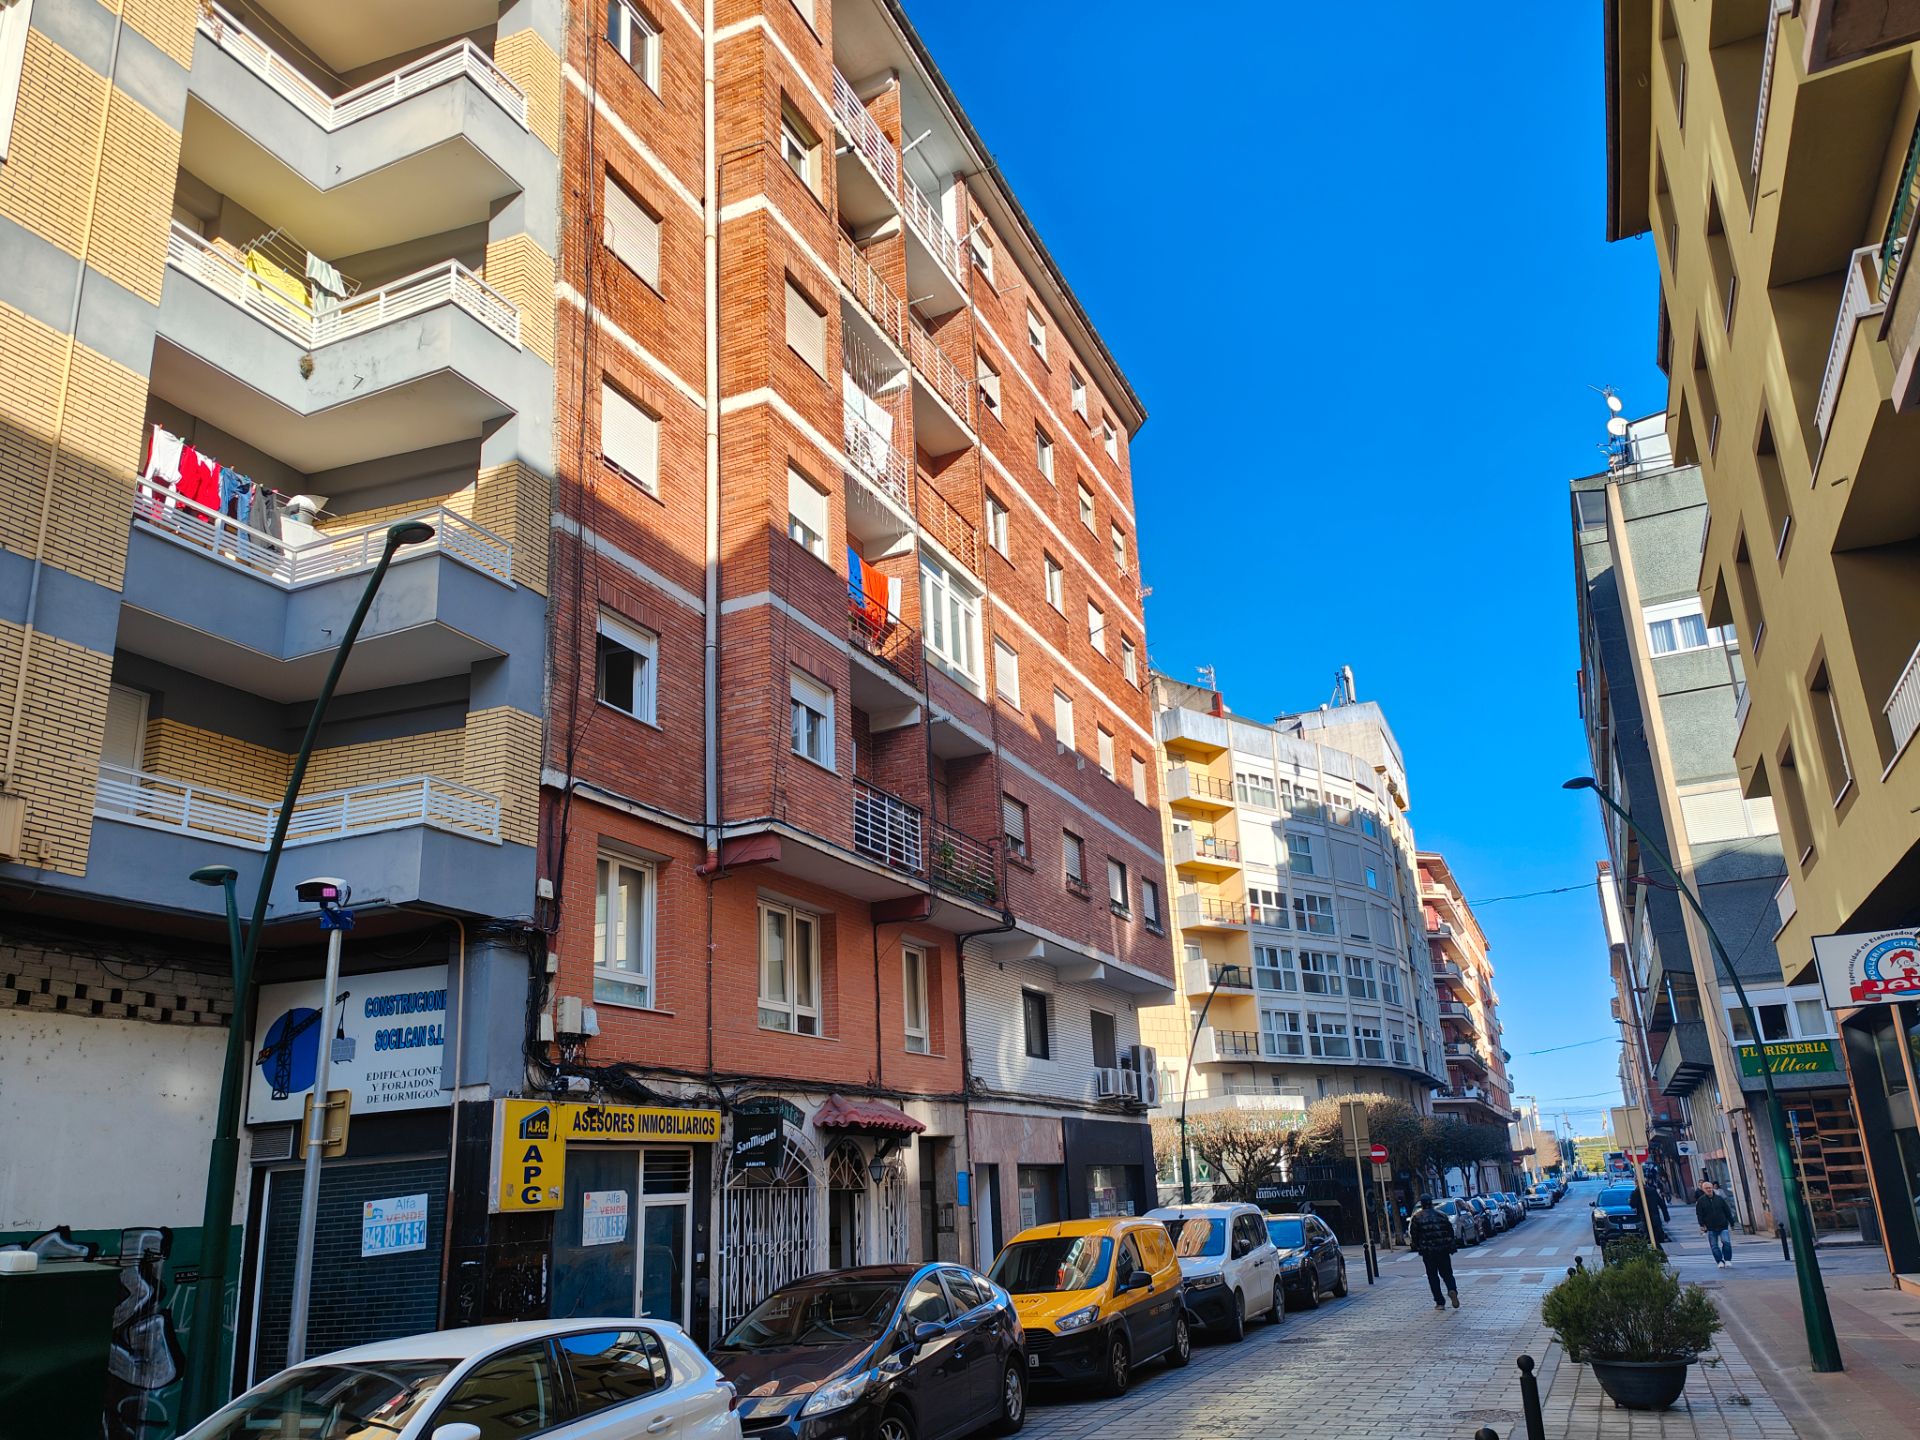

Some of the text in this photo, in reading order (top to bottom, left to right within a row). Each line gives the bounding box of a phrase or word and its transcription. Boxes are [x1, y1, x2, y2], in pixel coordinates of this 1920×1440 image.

[375, 1025, 427, 1051] SOCILCAN
[1742, 1042, 1829, 1057] FLRISTERIA
[372, 1078, 434, 1092] Y FORJADOS
[366, 1095, 380, 1104] DE
[572, 1110, 715, 1135] ASESORES INMOBILIARIOS
[396, 1198, 416, 1209] Alfa
[606, 1192, 621, 1203] Alfa
[600, 1205, 627, 1215] VENDE
[385, 1211, 425, 1223] VENDE
[364, 1226, 382, 1249] 942
[385, 1225, 396, 1248] 80
[399, 1223, 411, 1246] 15
